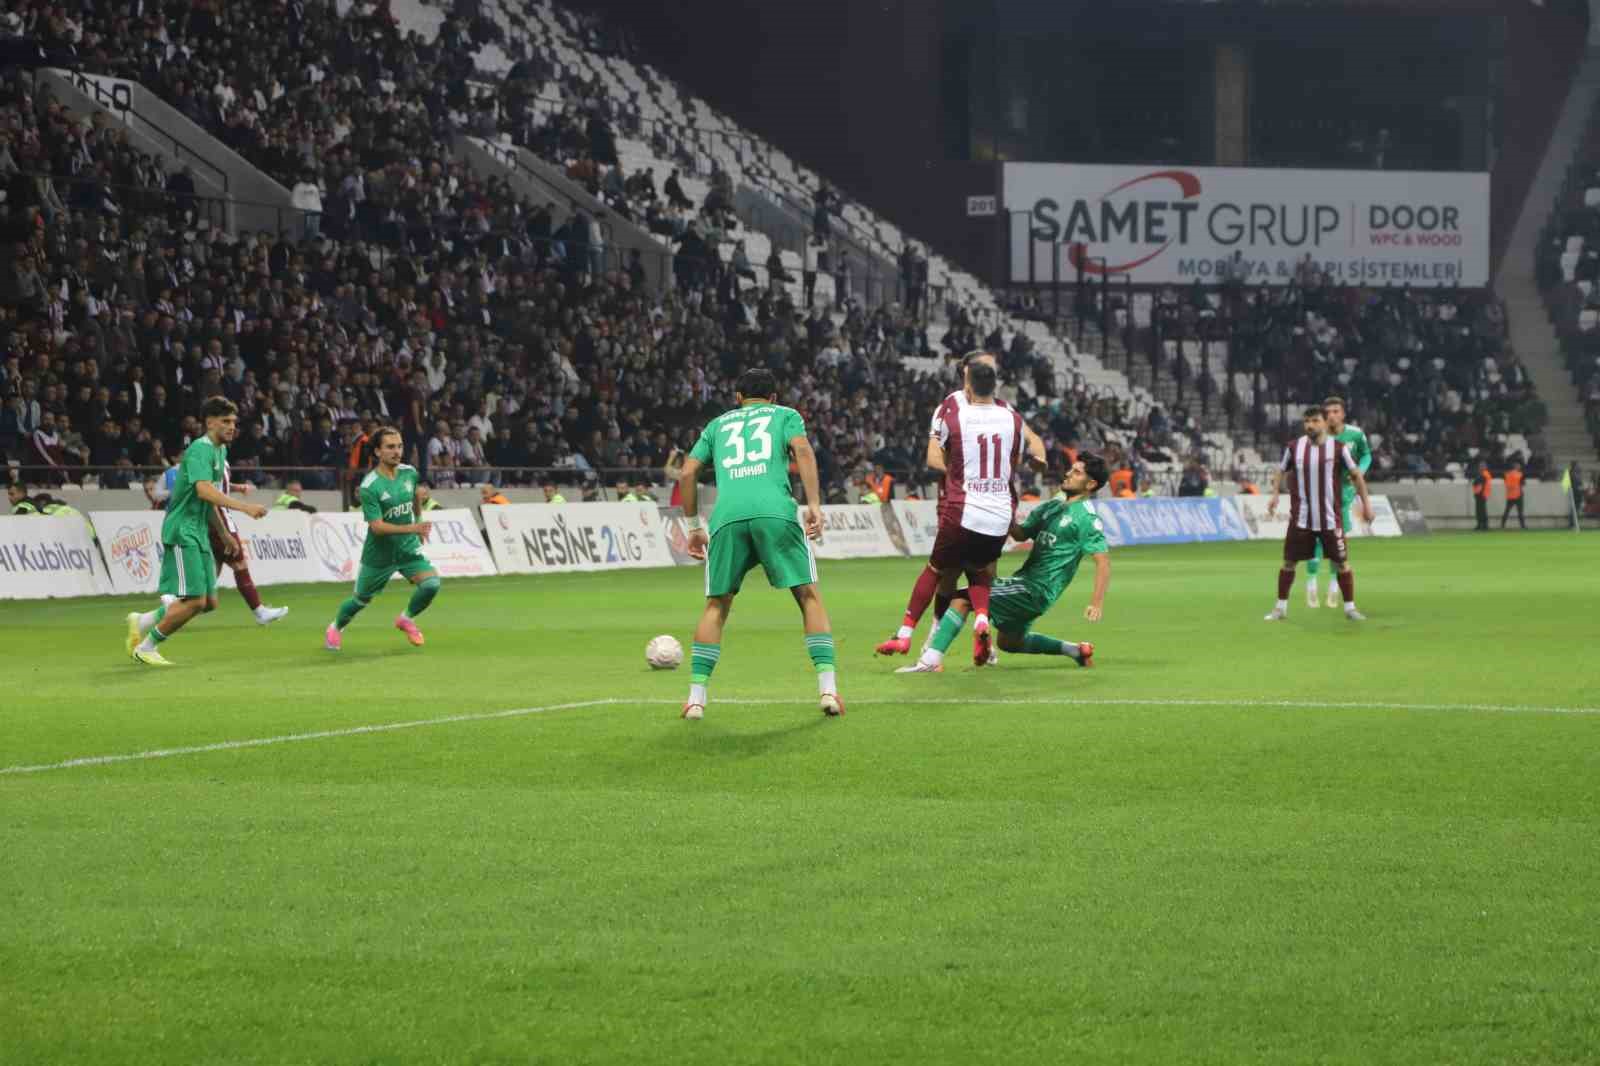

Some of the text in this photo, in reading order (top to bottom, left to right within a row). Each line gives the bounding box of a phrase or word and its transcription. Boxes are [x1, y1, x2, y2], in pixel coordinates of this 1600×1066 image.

[1031, 198, 1341, 247] SAMET GRUP
[1368, 205, 1461, 231] DOOR
[1369, 234, 1462, 247] WPC & WOOD
[1276, 260, 1290, 276] &
[1348, 256, 1463, 280] SİSTEMLERİ
[720, 416, 773, 468] 33
[976, 433, 1003, 480] 11
[12, 543, 94, 576] Kubilay
